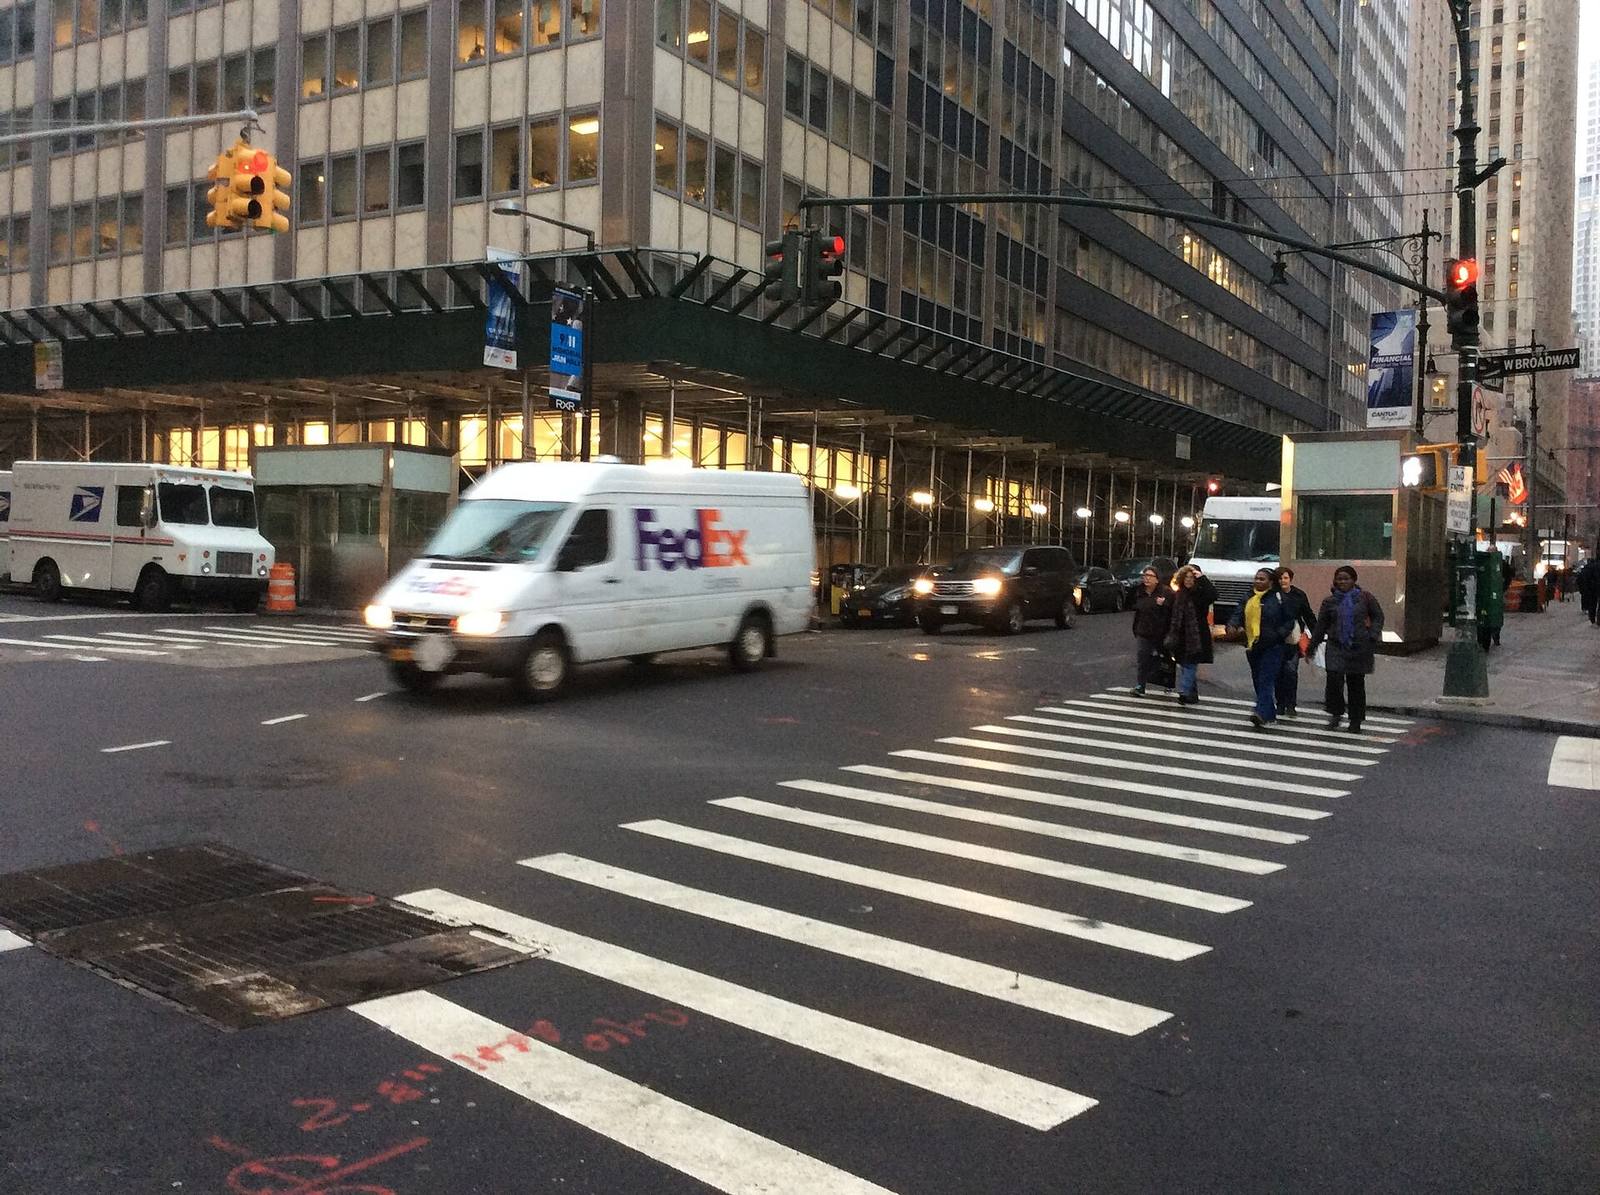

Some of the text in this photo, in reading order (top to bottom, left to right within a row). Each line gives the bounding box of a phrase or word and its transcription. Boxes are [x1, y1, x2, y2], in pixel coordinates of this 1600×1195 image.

[1371, 354, 1412, 364] FINANCIAL
[1504, 353, 1577, 370] W BROADWAY
[555, 399, 575, 411] RXR
[635, 508, 750, 570] FedEx
